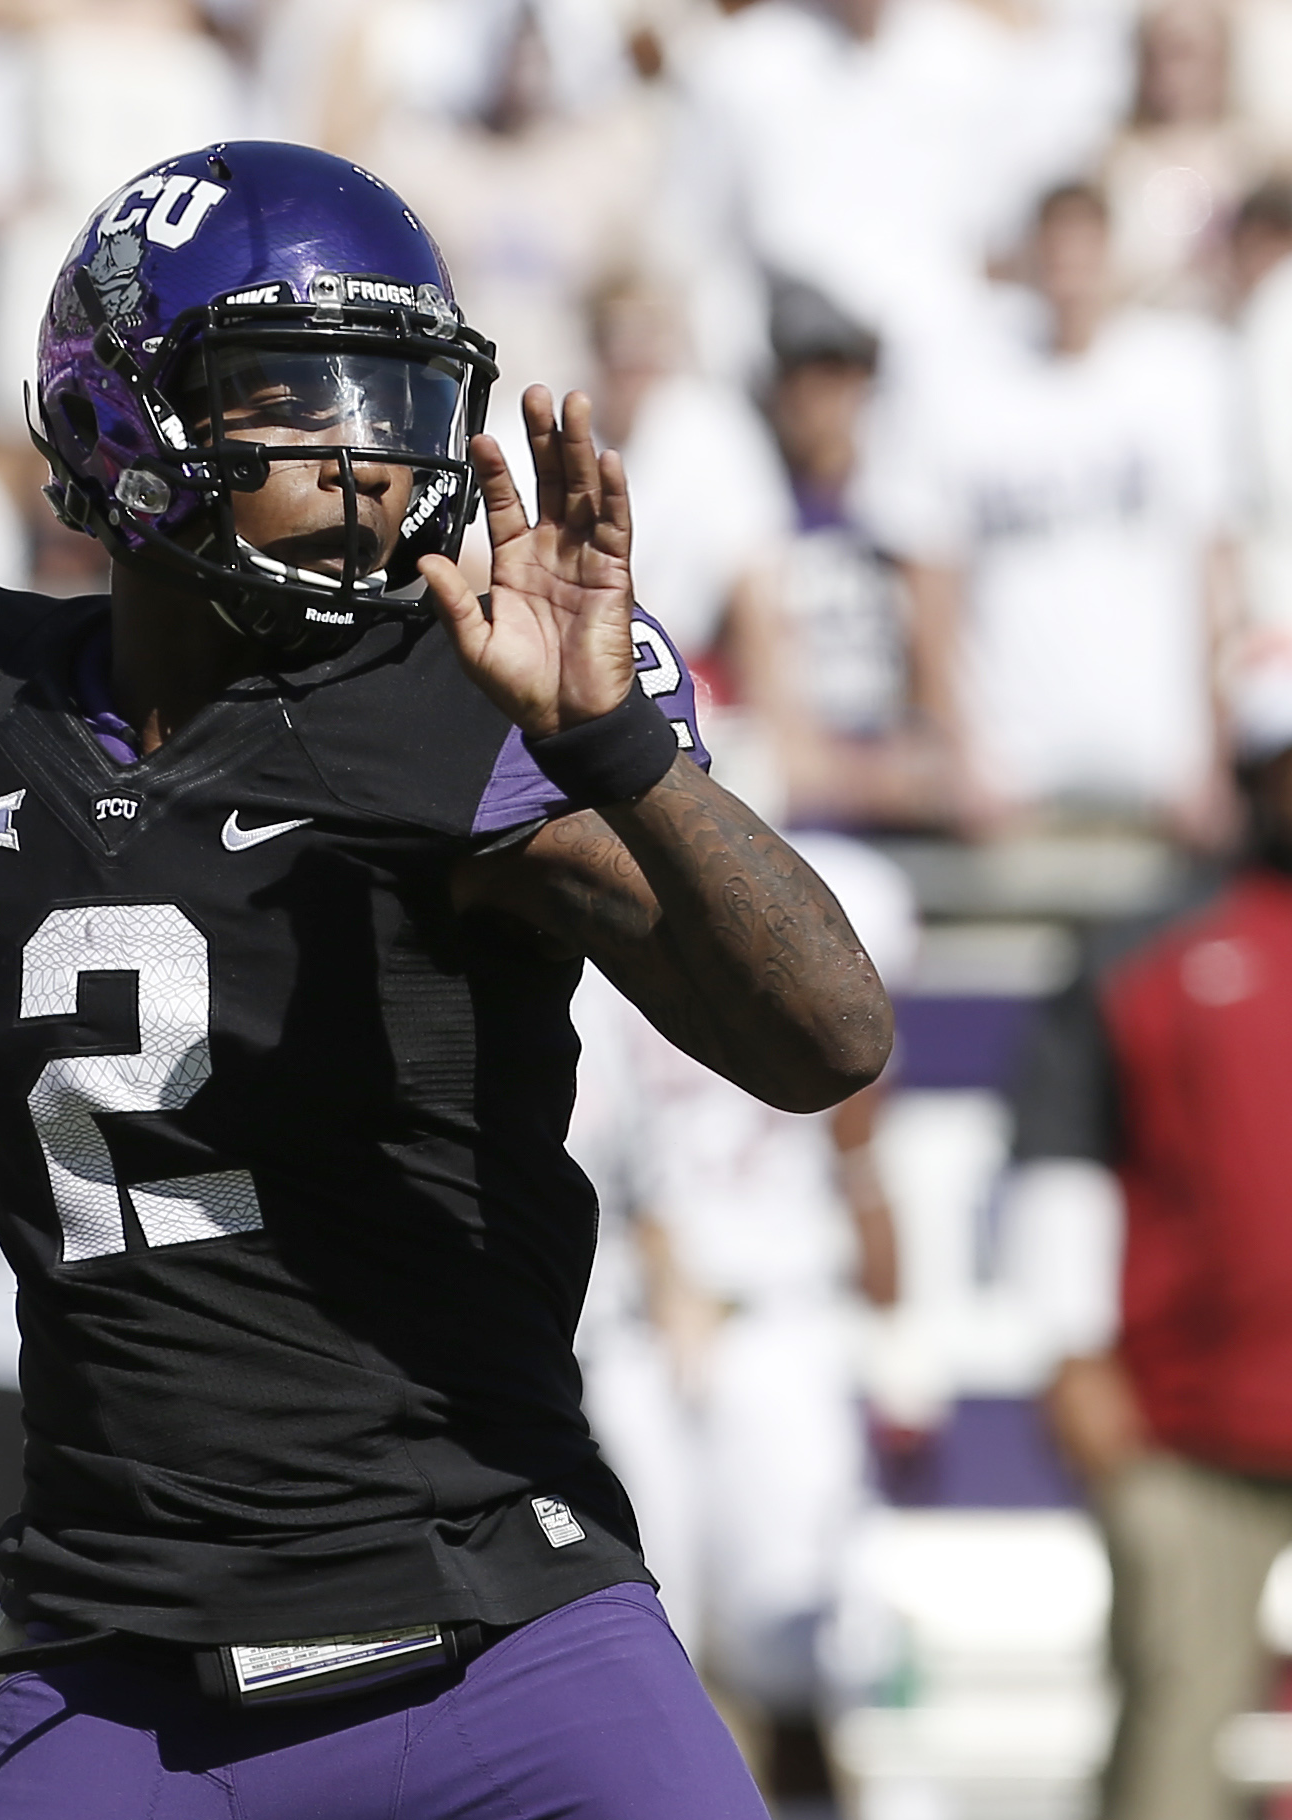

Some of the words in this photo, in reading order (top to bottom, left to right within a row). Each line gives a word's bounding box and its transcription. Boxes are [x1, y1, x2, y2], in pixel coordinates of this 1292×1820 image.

[346, 280, 412, 307] FROGS
[305, 607, 354, 625] Riddell
[96, 797, 138, 820] TCU
[18, 902, 264, 1262] 2
